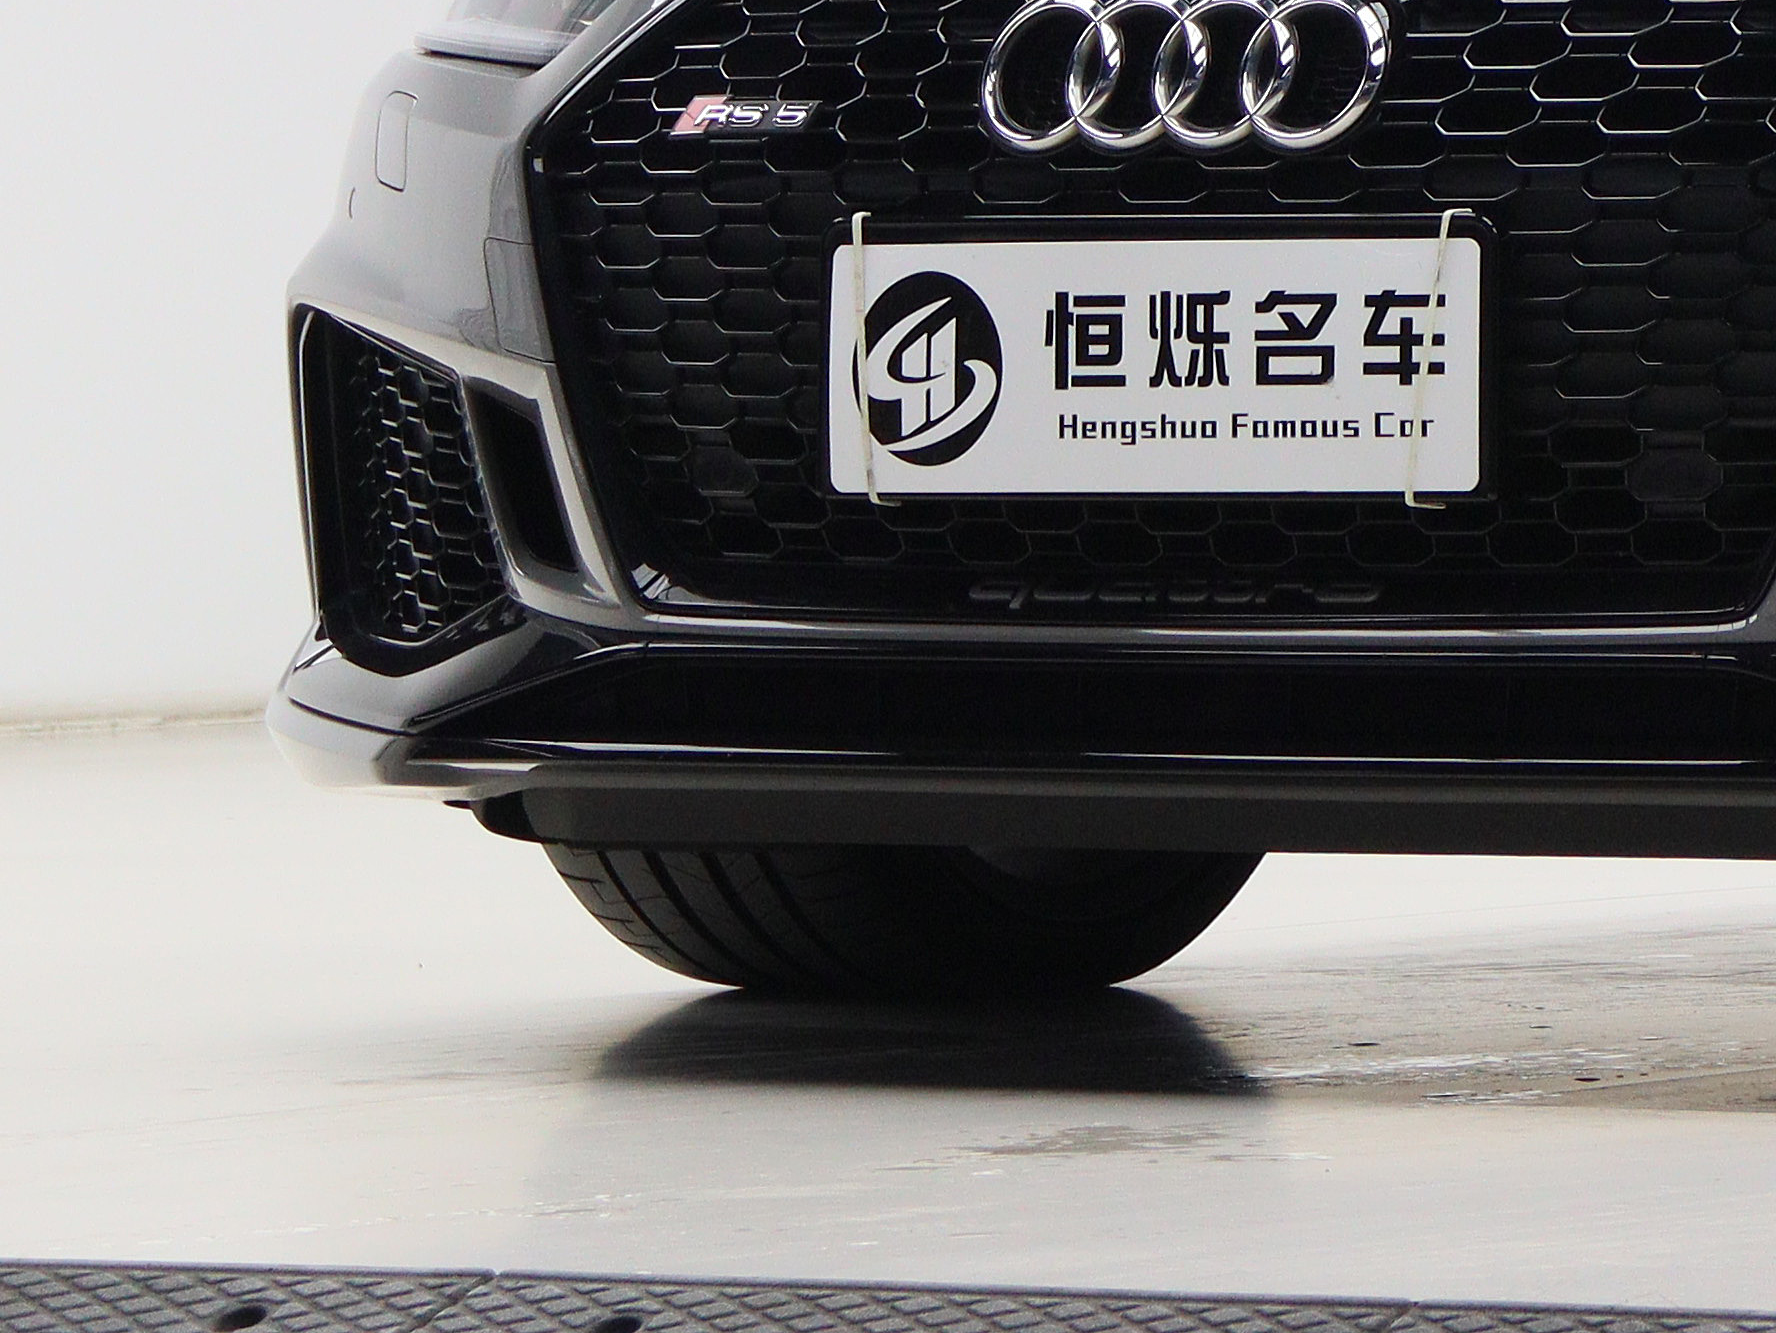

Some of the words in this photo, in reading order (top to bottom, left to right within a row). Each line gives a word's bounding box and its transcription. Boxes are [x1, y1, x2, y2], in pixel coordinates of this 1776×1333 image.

[693, 102, 770, 129] RS
[772, 102, 814, 129] 5
[1044, 289, 1447, 391] 恒烁名车
[1058, 413, 1219, 446] Hengshuo
[1231, 412, 1361, 439] Famous
[1373, 411, 1435, 439] Car
